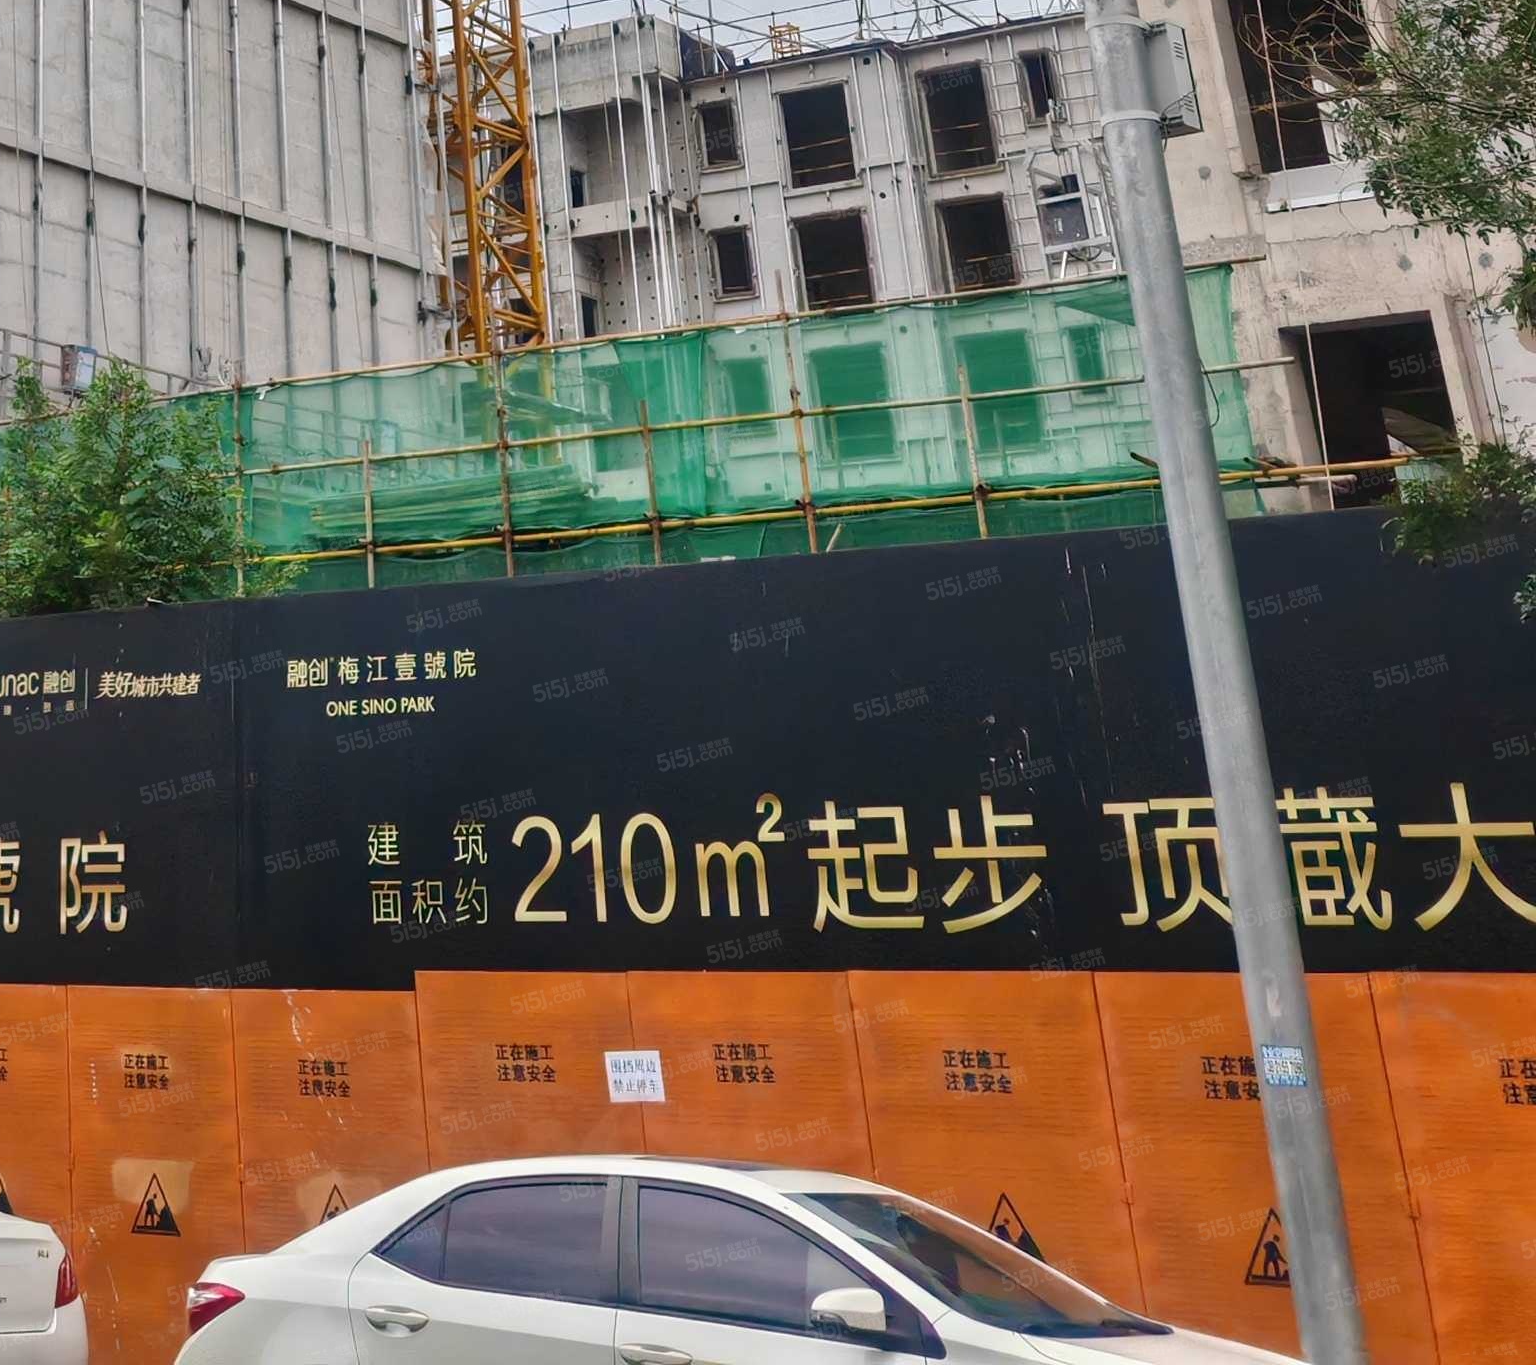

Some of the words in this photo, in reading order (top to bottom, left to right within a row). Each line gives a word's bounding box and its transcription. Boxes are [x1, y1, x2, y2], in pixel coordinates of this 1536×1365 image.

[43, 669, 75, 694] 融创
[94, 671, 202, 699] 美好城市共建者
[326, 700, 358, 717] ONE
[361, 697, 397, 715] SINO
[400, 695, 435, 714] PARK
[366, 820, 489, 866] 建筑
[368, 877, 489, 925] 面积约
[495, 1043, 554, 1061] 正在施工
[712, 1043, 772, 1061] 正在施工
[942, 1050, 1010, 1069] 正在施工
[497, 1064, 556, 1083] 注意安全
[716, 1066, 776, 1083] 注意安全
[1200, 1054, 1257, 1076] 正在施
[945, 1072, 1013, 1093] 注意安全
[1204, 1080, 1261, 1101] 注意安
